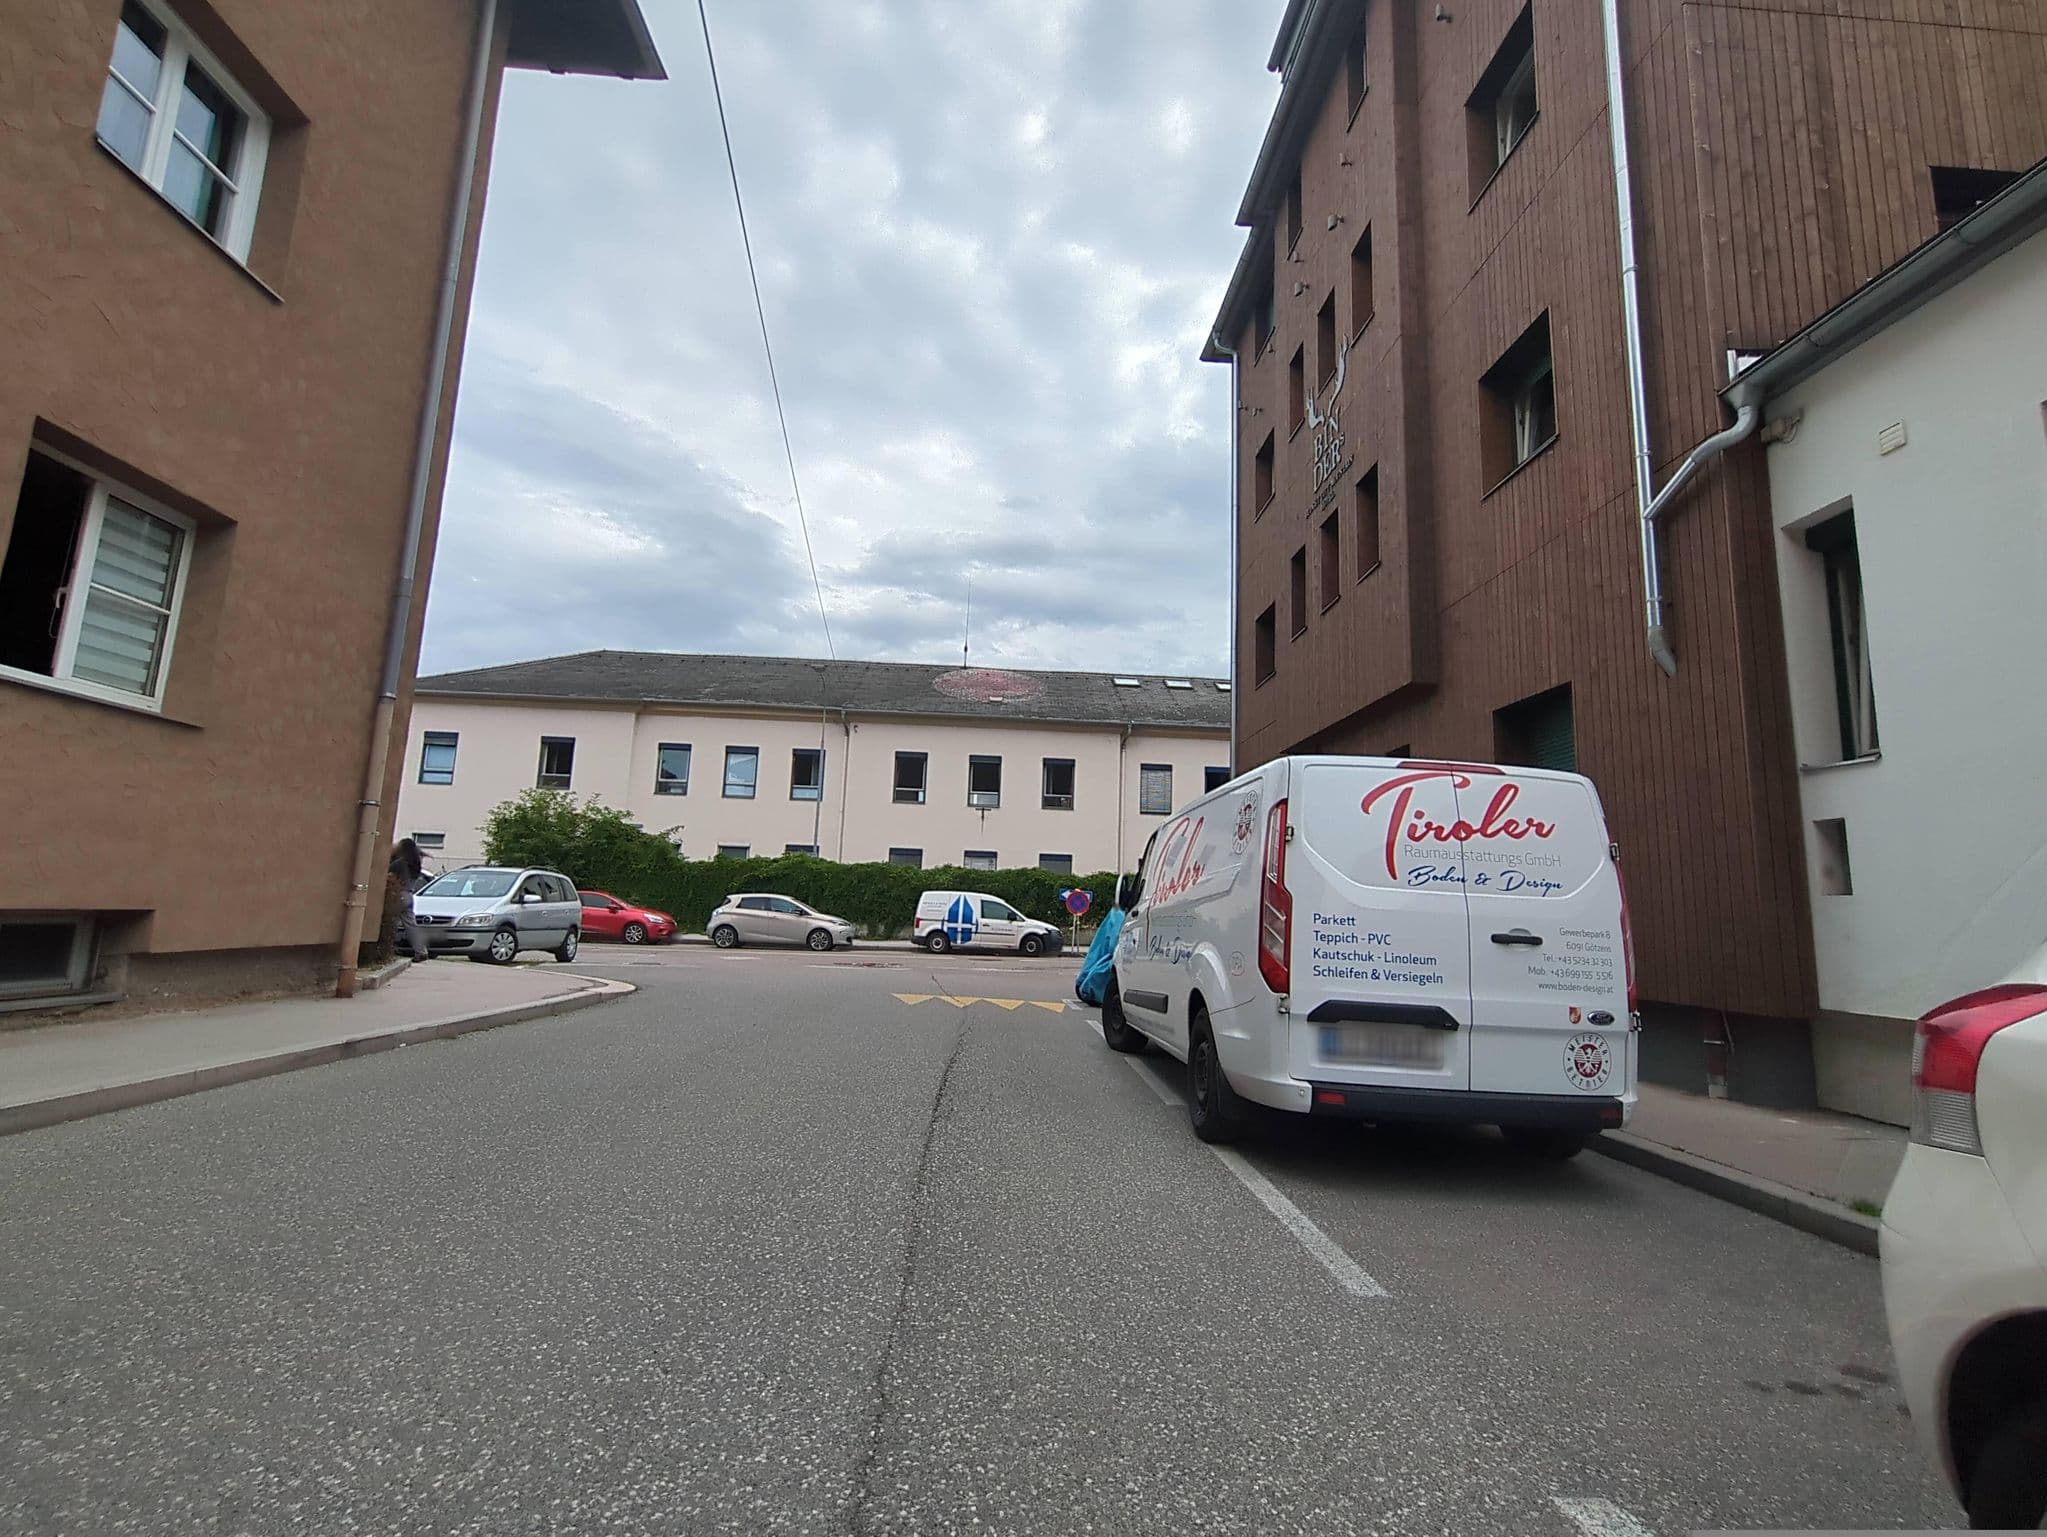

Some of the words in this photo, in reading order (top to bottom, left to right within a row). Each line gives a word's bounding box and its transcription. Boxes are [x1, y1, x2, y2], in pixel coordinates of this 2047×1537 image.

[1361, 772, 1555, 880] Tiroler
[1404, 844, 1522, 868] Raumausstattungs
[1525, 852, 1562, 868] GmbH
[1408, 865, 1468, 887] Boden
[1474, 872, 1492, 886] &
[1496, 870, 1564, 897] Design
[1313, 913, 1356, 926] Parkett
[1313, 930, 1358, 945] Teppich
[1368, 933, 1391, 945] PVC
[1313, 948, 1375, 962] Kautschuk
[1384, 952, 1437, 965] Linoleum
[1313, 965, 1368, 979] Schleifen
[1371, 969, 1380, 980] &
[1383, 969, 1443, 986] Versiegeln
